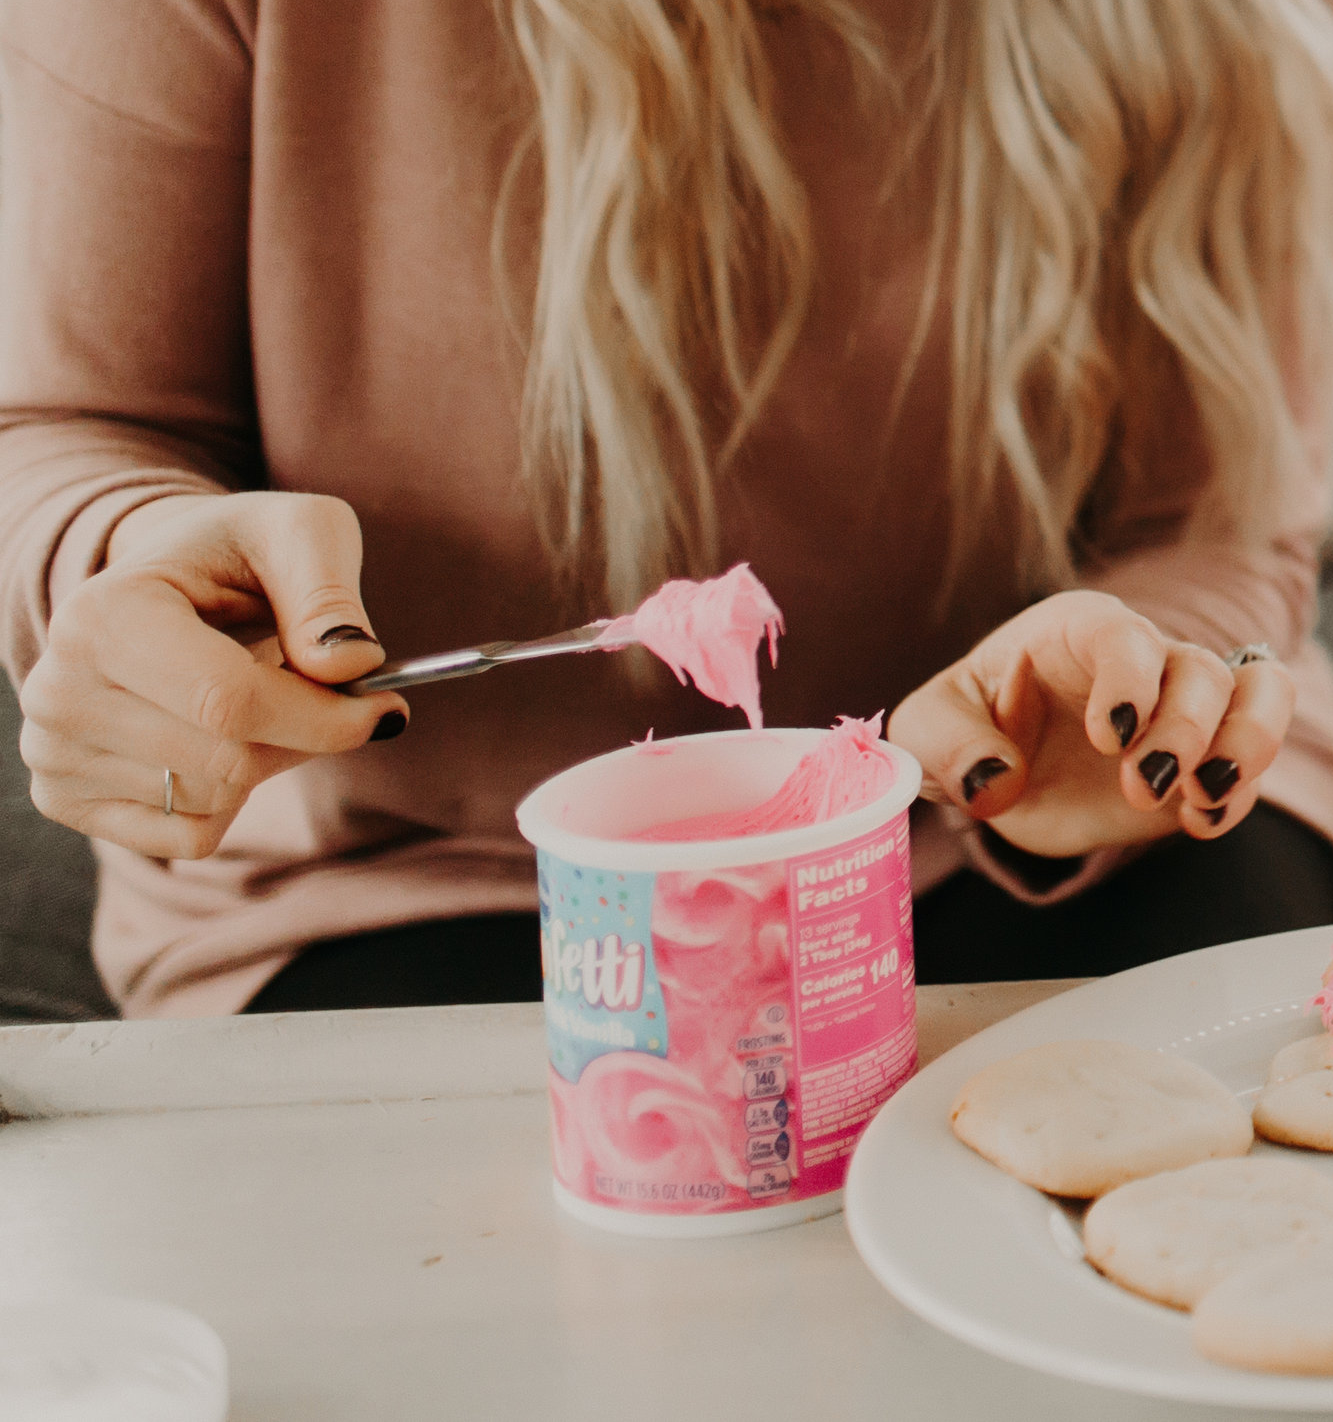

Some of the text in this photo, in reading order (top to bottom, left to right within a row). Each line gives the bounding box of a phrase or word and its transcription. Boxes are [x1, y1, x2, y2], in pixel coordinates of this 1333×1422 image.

[797, 838, 895, 889] Nutrition
[798, 877, 868, 913] Facts
[801, 965, 866, 996] Calories
[870, 947, 899, 985] 140
[754, 1070, 776, 1088] 140
